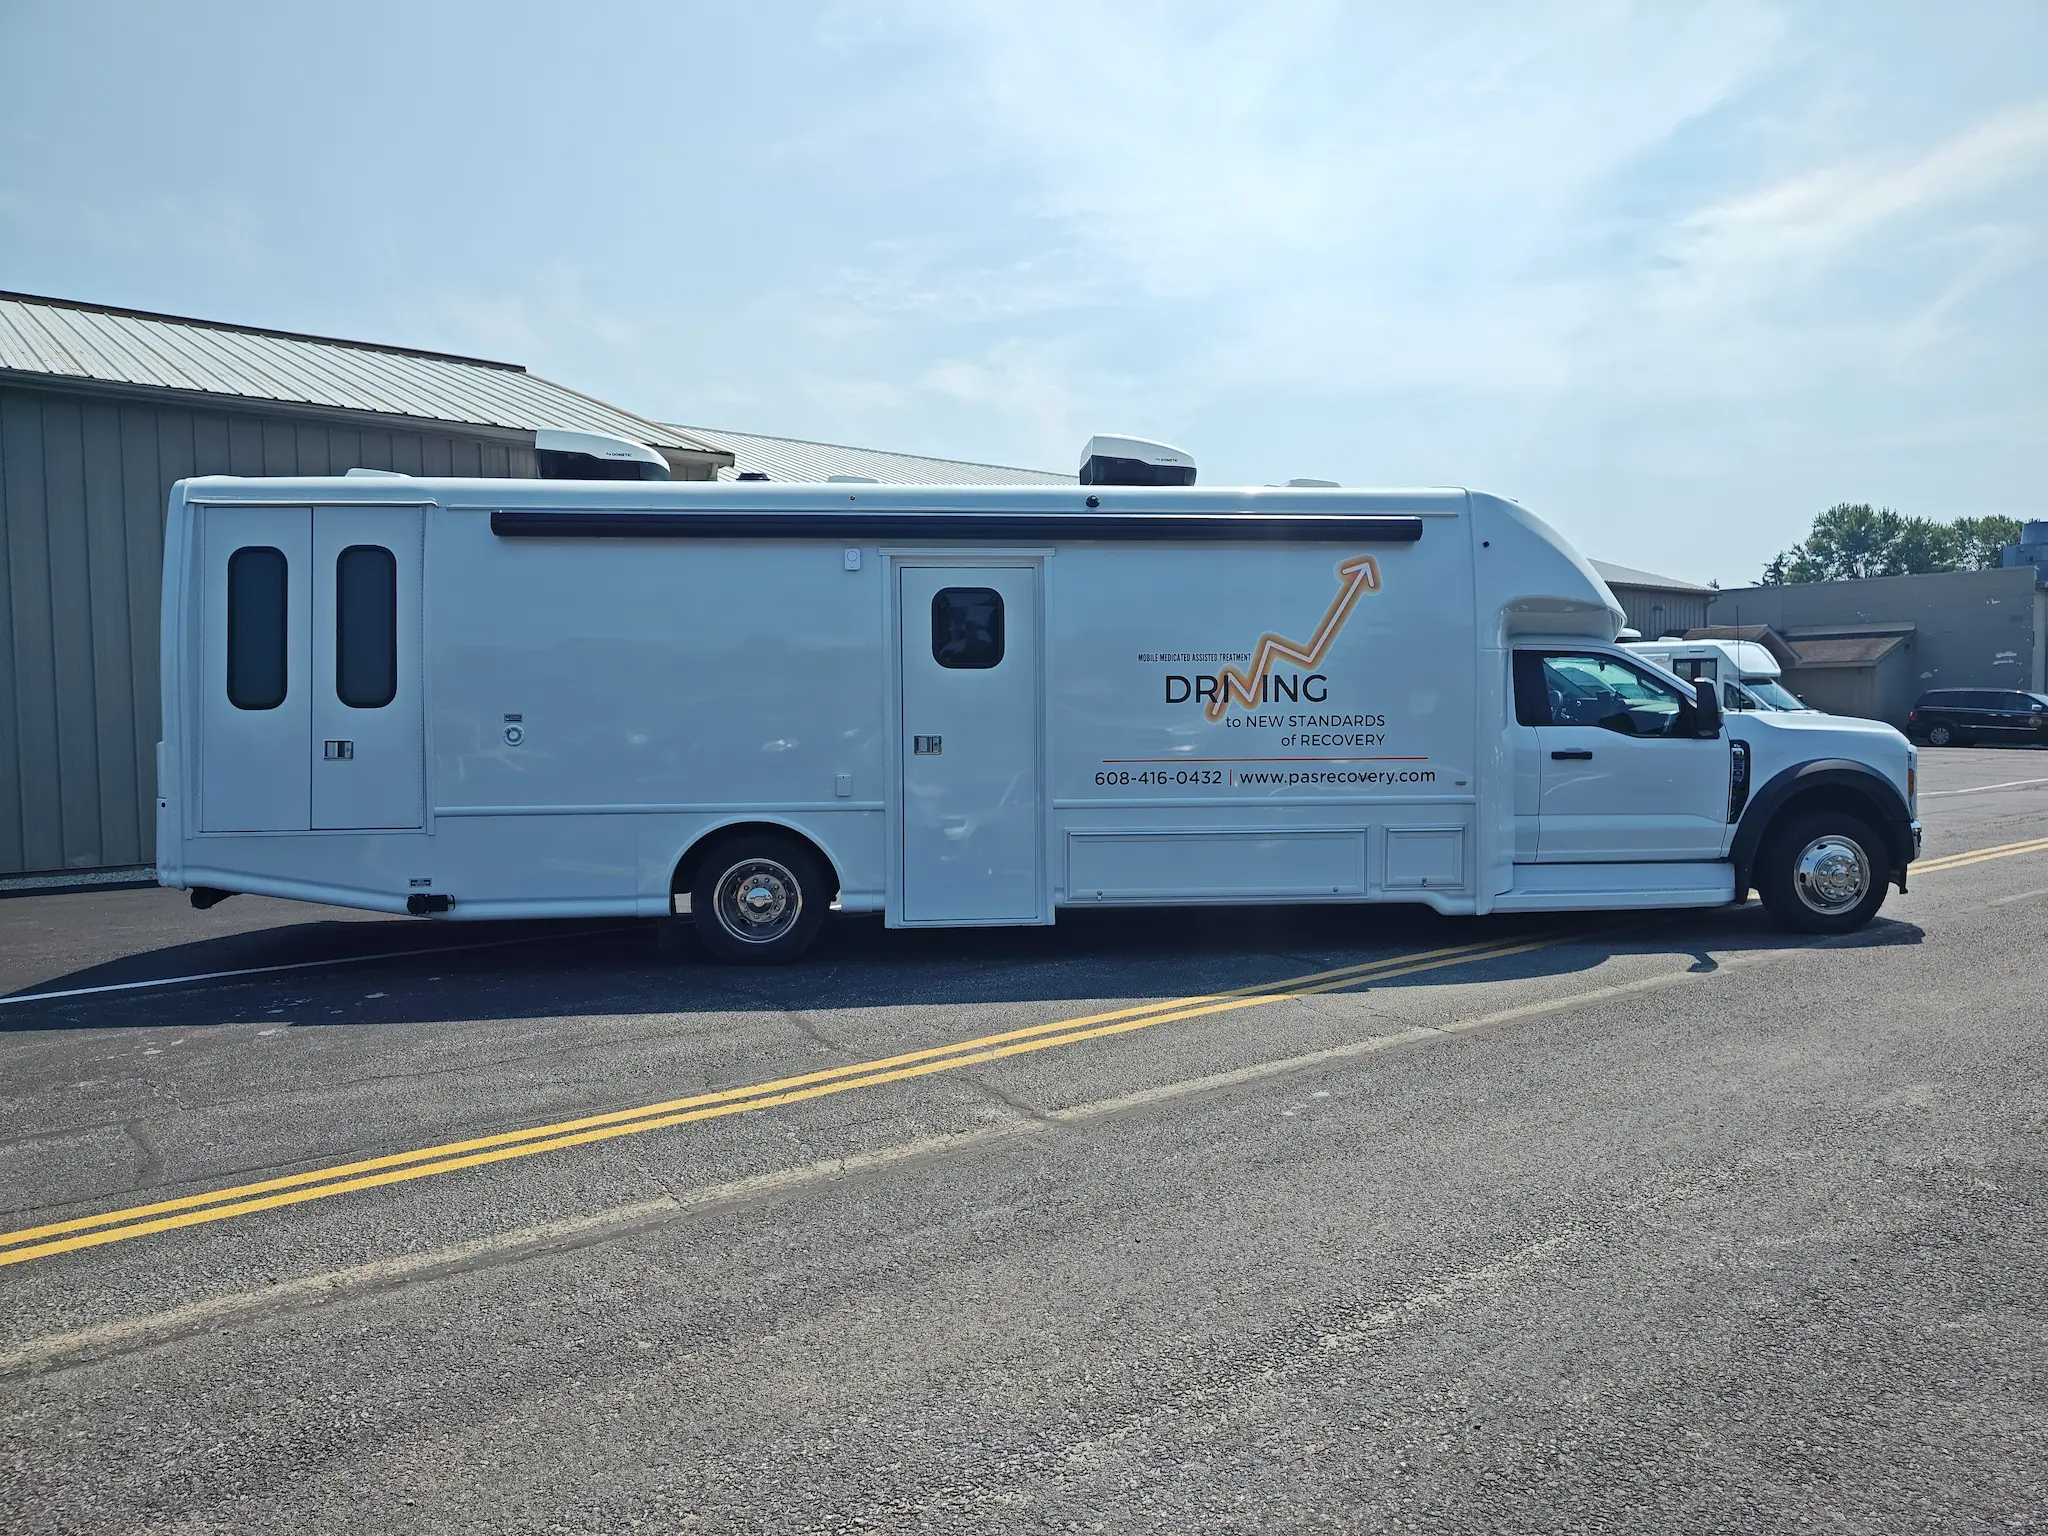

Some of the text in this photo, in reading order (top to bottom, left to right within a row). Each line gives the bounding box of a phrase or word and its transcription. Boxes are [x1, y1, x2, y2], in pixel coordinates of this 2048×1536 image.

[1138, 653, 1252, 662] MOBILE MEDICATED ASSISTED TREATMENT
[1165, 674, 1328, 703] DRIVING
[1226, 714, 1386, 728] to NEW STANDARDS
[1281, 734, 1386, 747] of RECOVERY
[1094, 770, 1436, 786] 608-416-0432 www.pasrecovery.com
